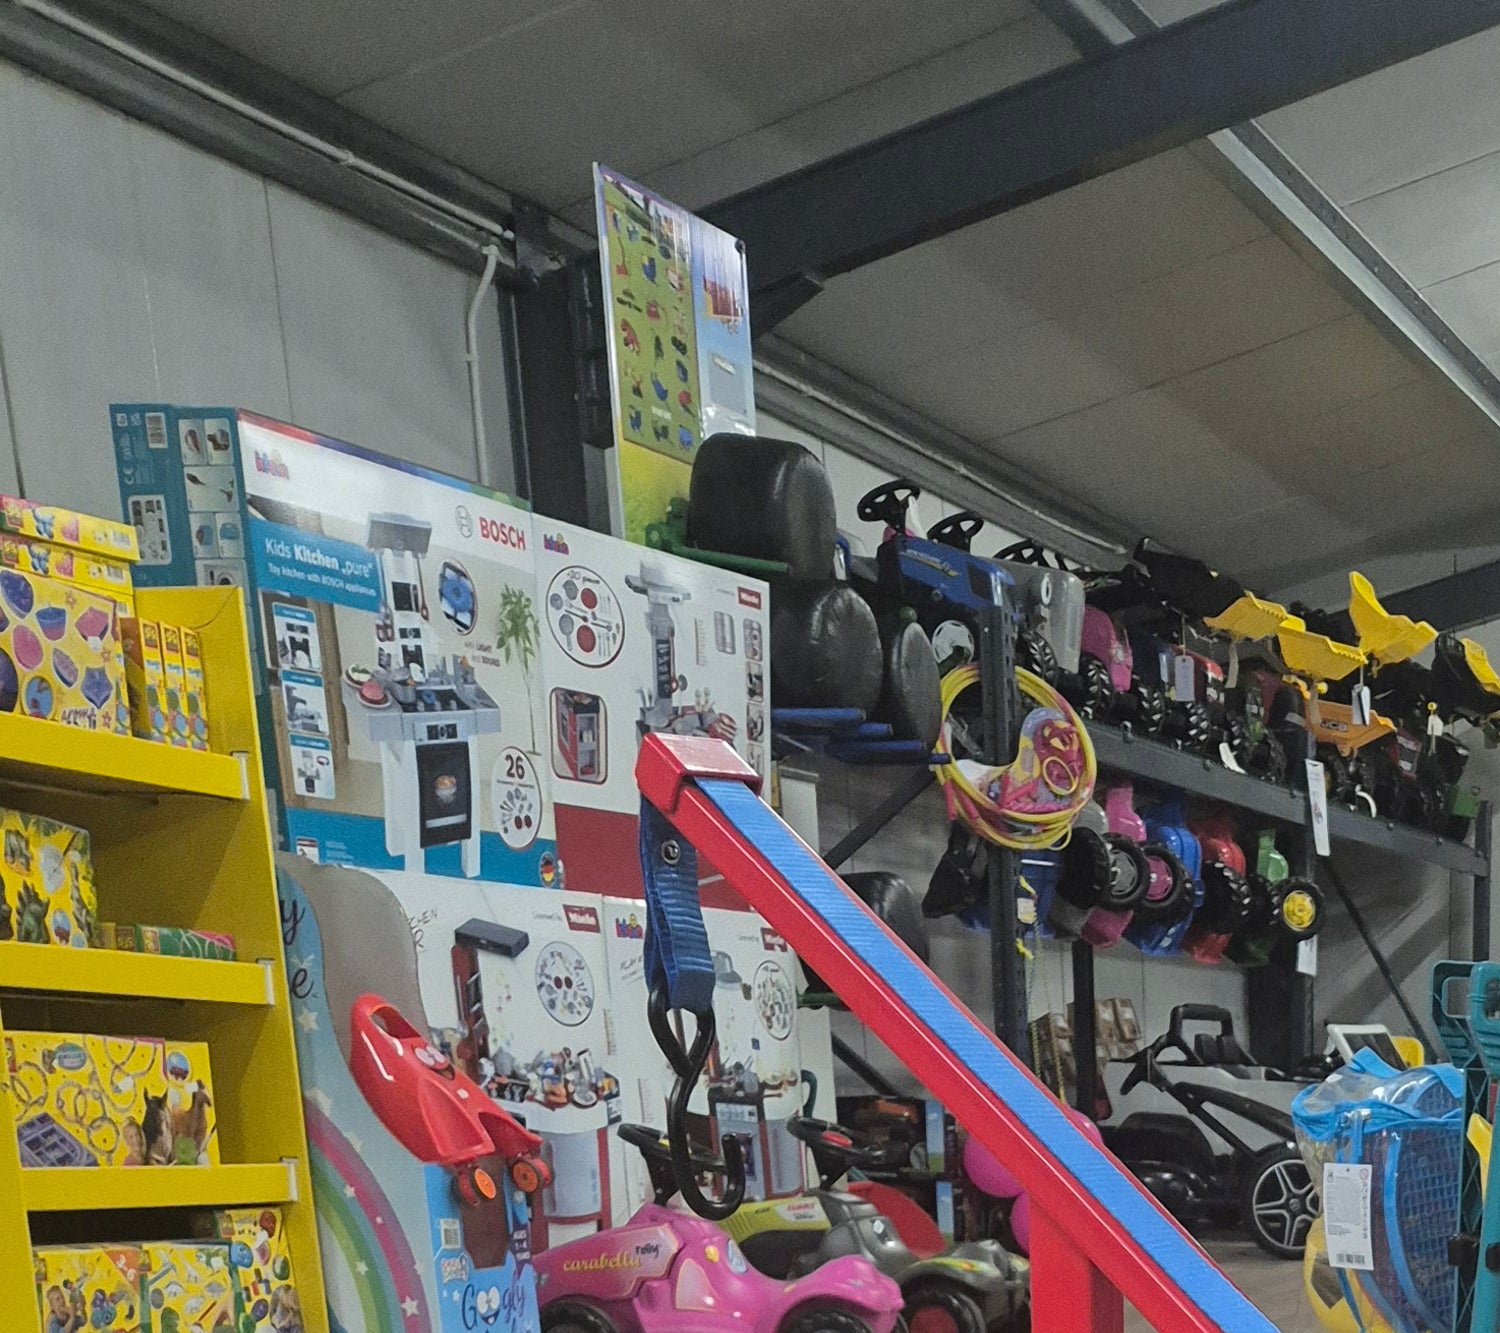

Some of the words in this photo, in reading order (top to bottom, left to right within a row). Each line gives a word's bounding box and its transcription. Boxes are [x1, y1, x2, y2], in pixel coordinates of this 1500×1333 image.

[479, 516, 526, 551] BOSCH
[265, 538, 292, 559] Kids
[293, 543, 340, 571] Kitchen
[505, 754, 526, 780] 26
